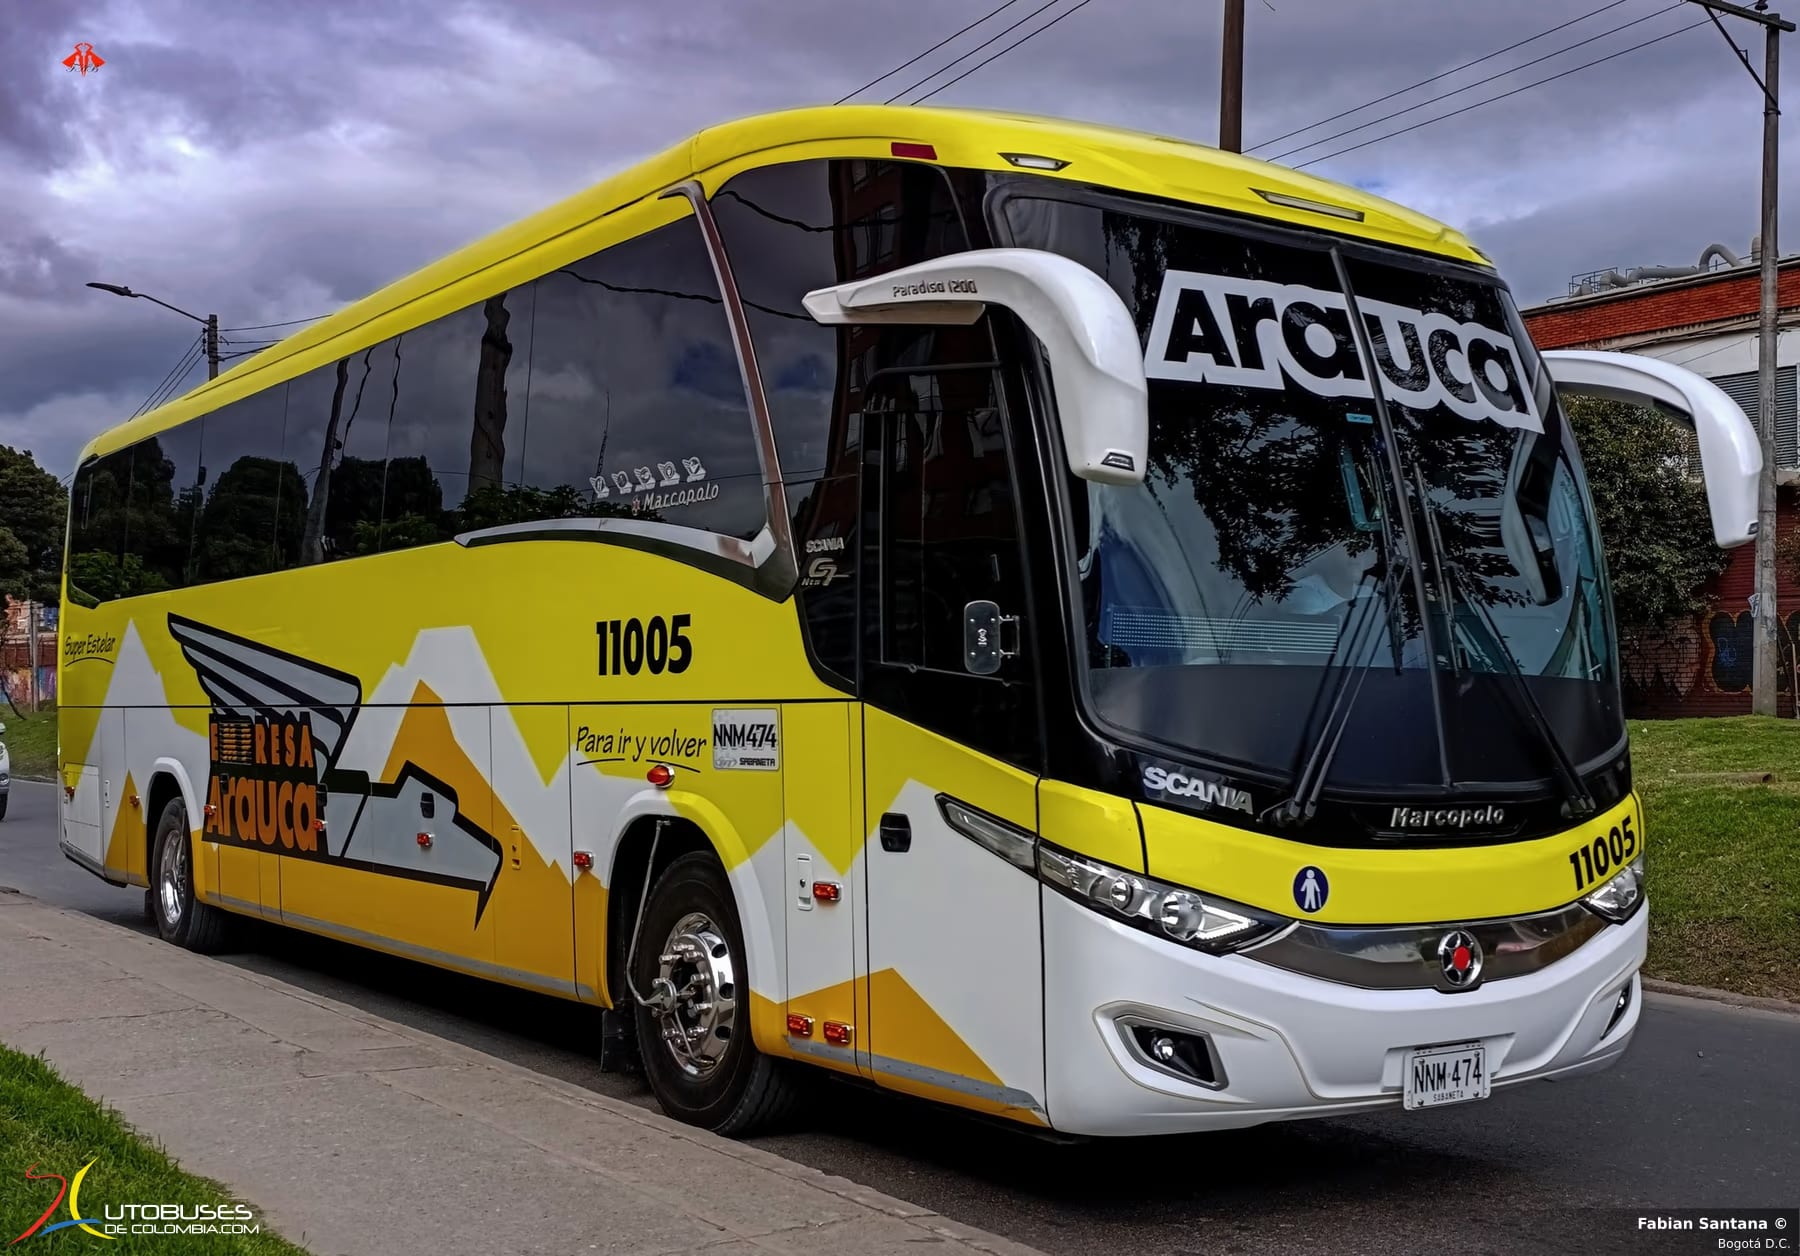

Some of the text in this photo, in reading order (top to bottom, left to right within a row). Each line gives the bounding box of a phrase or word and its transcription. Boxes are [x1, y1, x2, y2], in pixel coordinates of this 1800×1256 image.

[893, 279, 978, 297] Paradiso 1200
[1163, 287, 1531, 416] Arauca
[642, 481, 720, 512] Marcopolo
[805, 536, 845, 553] SCANIA
[64, 631, 116, 661] Super Estelar
[596, 613, 693, 677] 11005
[210, 722, 314, 768] ERESA
[576, 726, 707, 763] Para ir y volver
[739, 757, 776, 767] SABANETA
[1142, 766, 1254, 815] SCANIA
[206, 775, 318, 851] Arauca
[1390, 806, 1505, 828] Marcopolo
[1569, 817, 1637, 892] 11005
[1433, 1091, 1464, 1102] SABANETA
